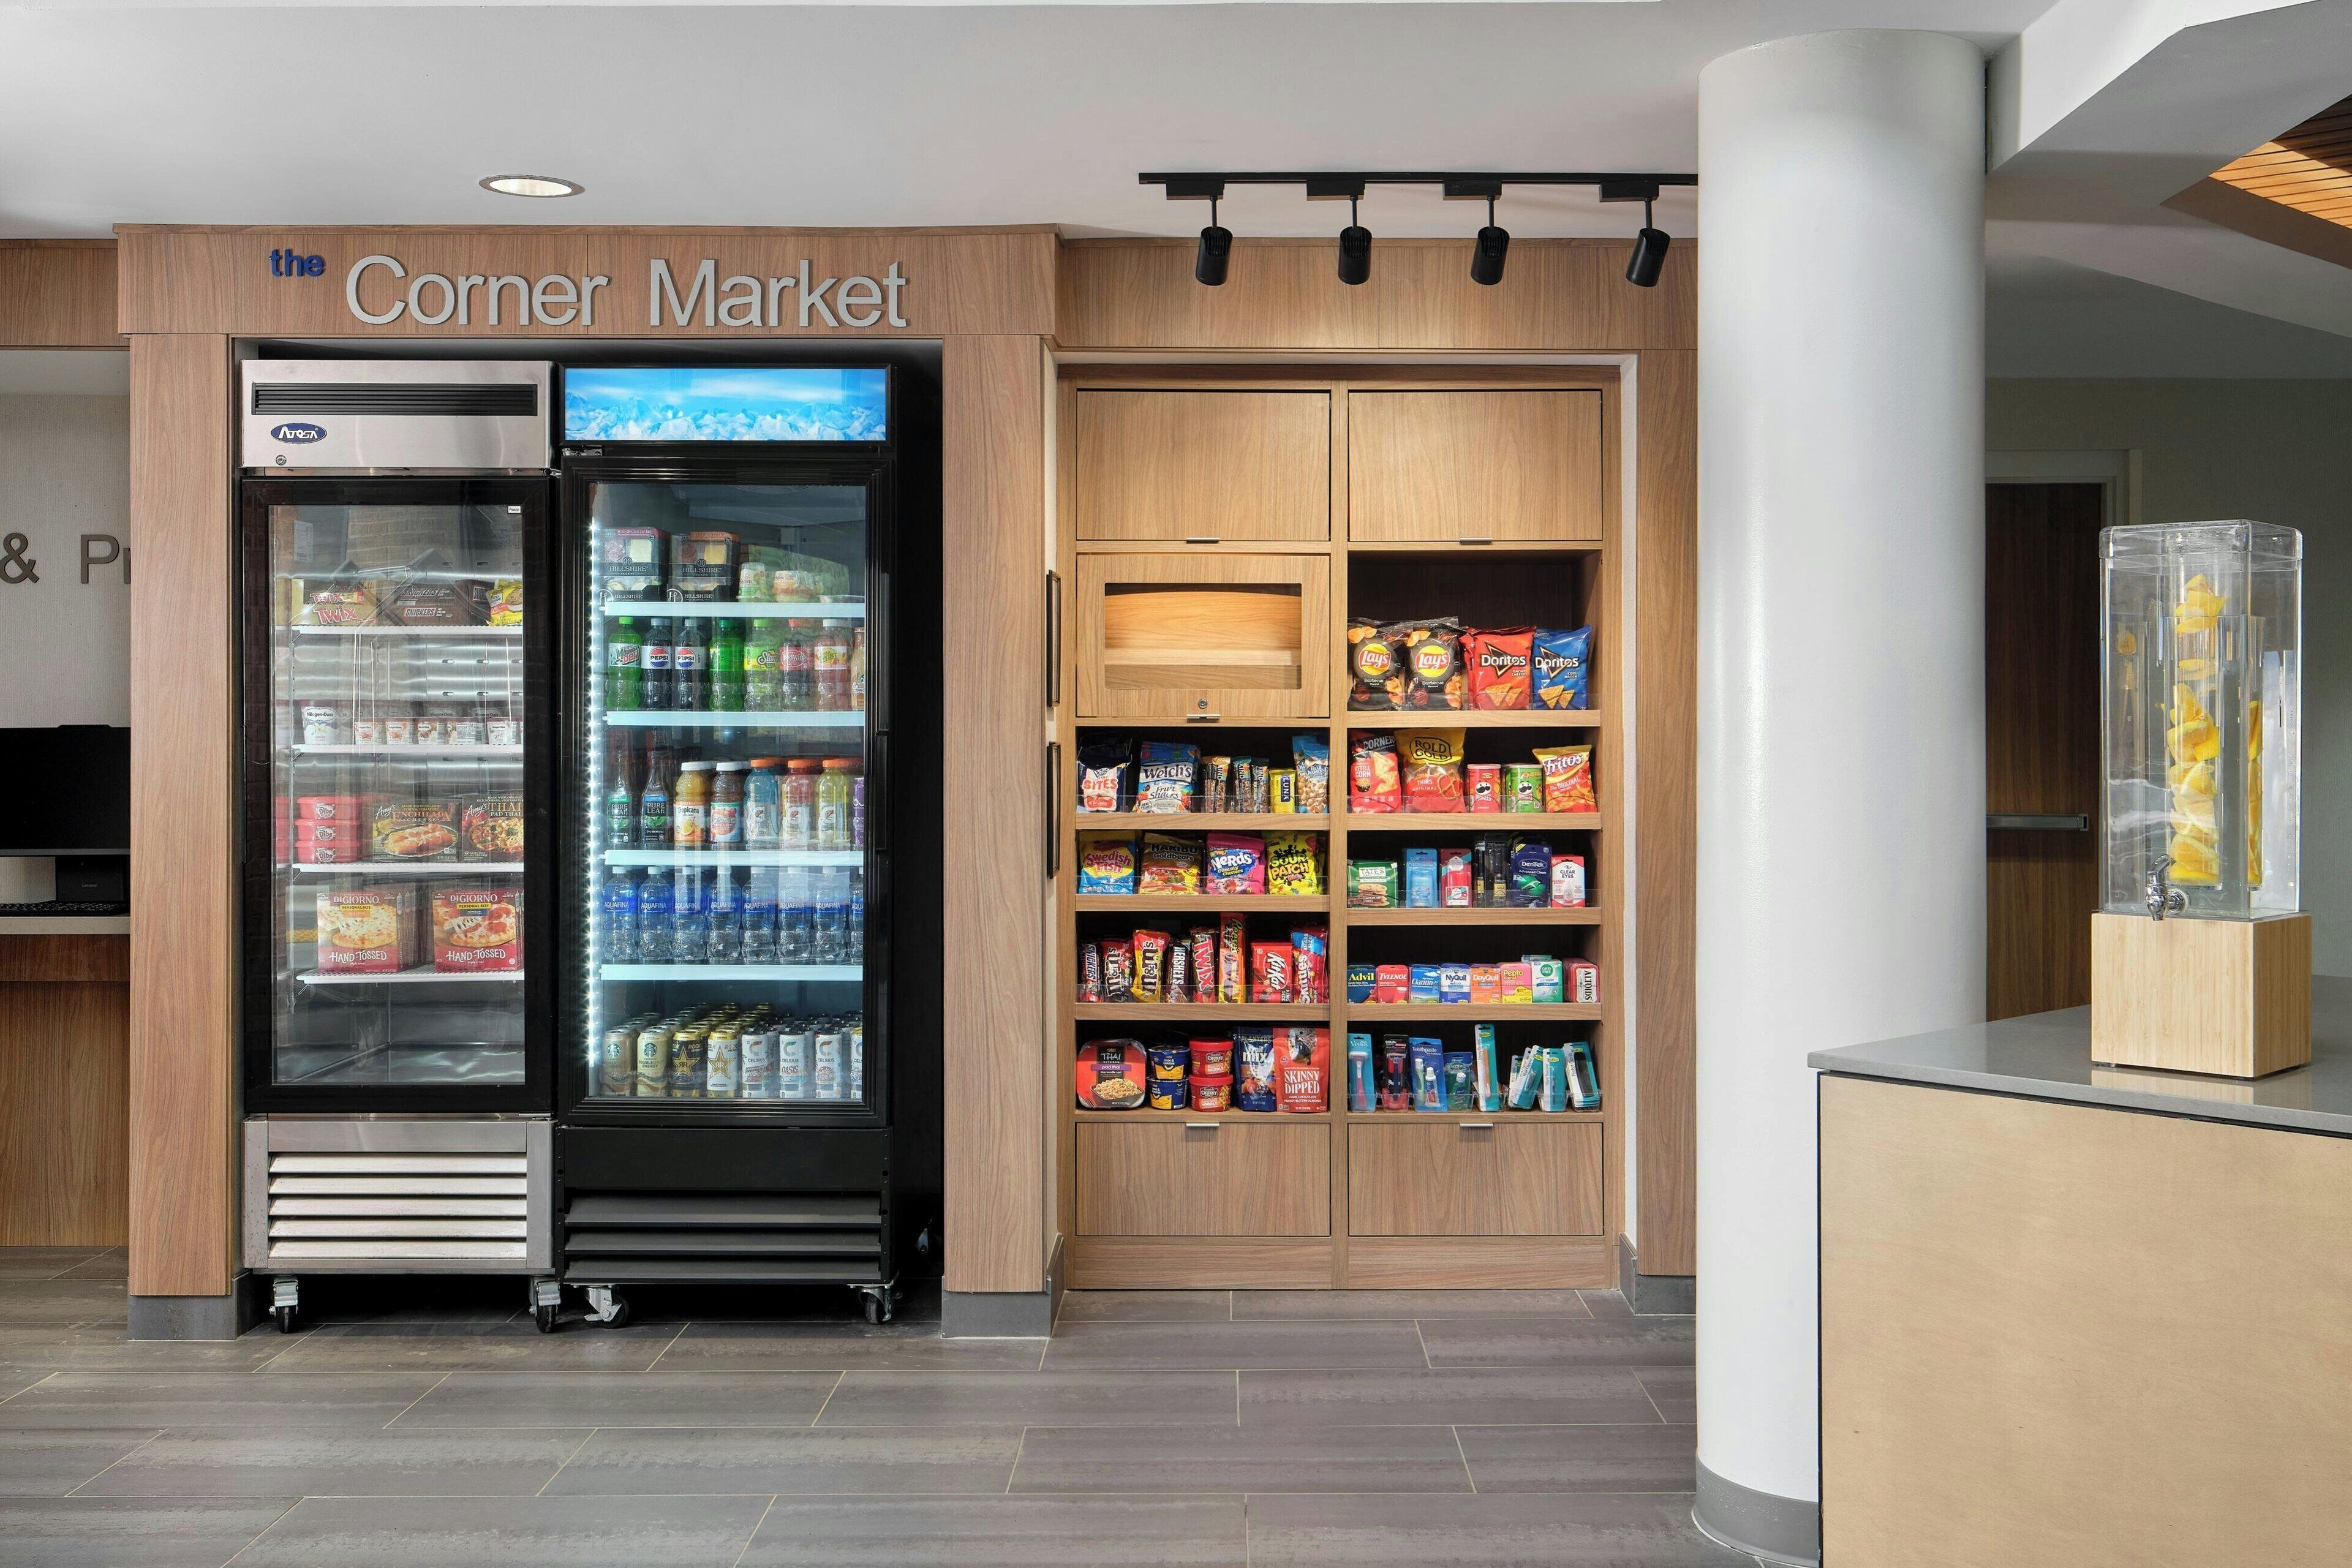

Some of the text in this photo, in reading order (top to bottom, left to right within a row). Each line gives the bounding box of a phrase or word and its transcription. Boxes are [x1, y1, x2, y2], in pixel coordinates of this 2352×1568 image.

[270, 249, 907, 328] the Corner Market
[0, 533, 39, 584] &
[404, 608, 435, 617] SNICKERS
[1361, 650, 1390, 668] Lay's
[1418, 652, 1449, 670] Lay's
[1481, 655, 1526, 666] Doritos
[1535, 657, 1580, 668] Doritos
[1415, 739, 1447, 754] ROLD
[1415, 748, 1449, 761] GOLD
[1544, 753, 1583, 776] Fritos
[1143, 764, 1192, 780] Welch's
[1558, 777, 1580, 788] ORIGINAL
[1156, 785, 1177, 794] Fruit
[375, 804, 397, 820] Amy's
[465, 803, 488, 820] Amy's
[490, 802, 522, 812] THAI
[392, 812, 451, 822] ENCHILADA
[1151, 843, 1199, 854] HARIBO
[1083, 851, 1133, 867] Swedish
[1153, 852, 1195, 862] Goldbears
[1271, 853, 1308, 867] SOUR
[1095, 861, 1123, 873] Fish
[1272, 862, 1310, 879] PATCH
[1086, 944, 1096, 981] SNICKERS
[1473, 974, 1499, 983] DayQuil
[1584, 970, 1593, 1001] ALTOIDS
[1101, 1052, 1121, 1061] THAI
[1242, 1052, 1268, 1063] mix
[782, 1065, 799, 1074] OASIS
[1284, 1070, 1320, 1084] SKINNY
[1284, 1081, 1321, 1094] DIPPED
